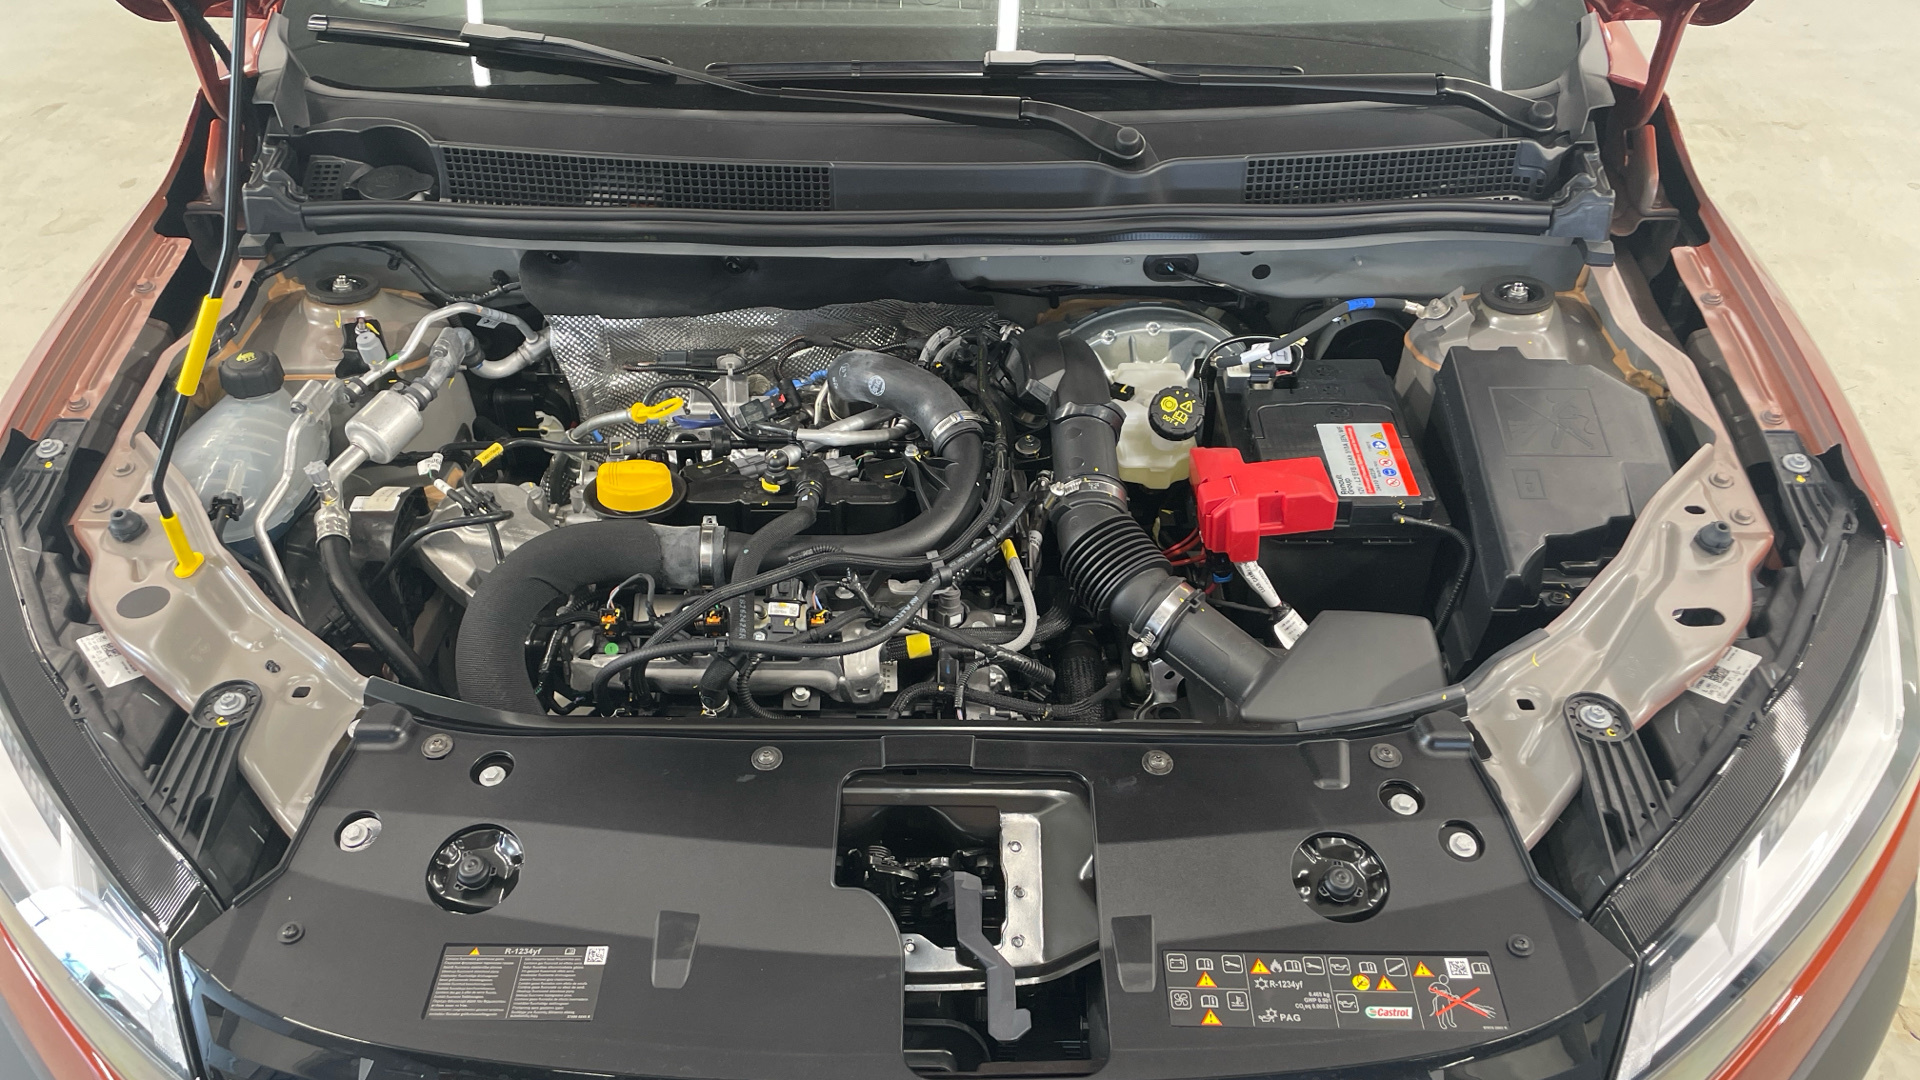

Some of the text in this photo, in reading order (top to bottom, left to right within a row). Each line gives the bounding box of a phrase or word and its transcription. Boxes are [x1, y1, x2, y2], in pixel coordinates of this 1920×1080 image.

[1162, 414, 1174, 423] DOT
[1336, 475, 1346, 494] Renault
[1344, 478, 1354, 494] Group
[504, 948, 542, 957] R-1234yf
[1269, 980, 1303, 990] R-1234yf
[1378, 1008, 1409, 1016] Castrol
